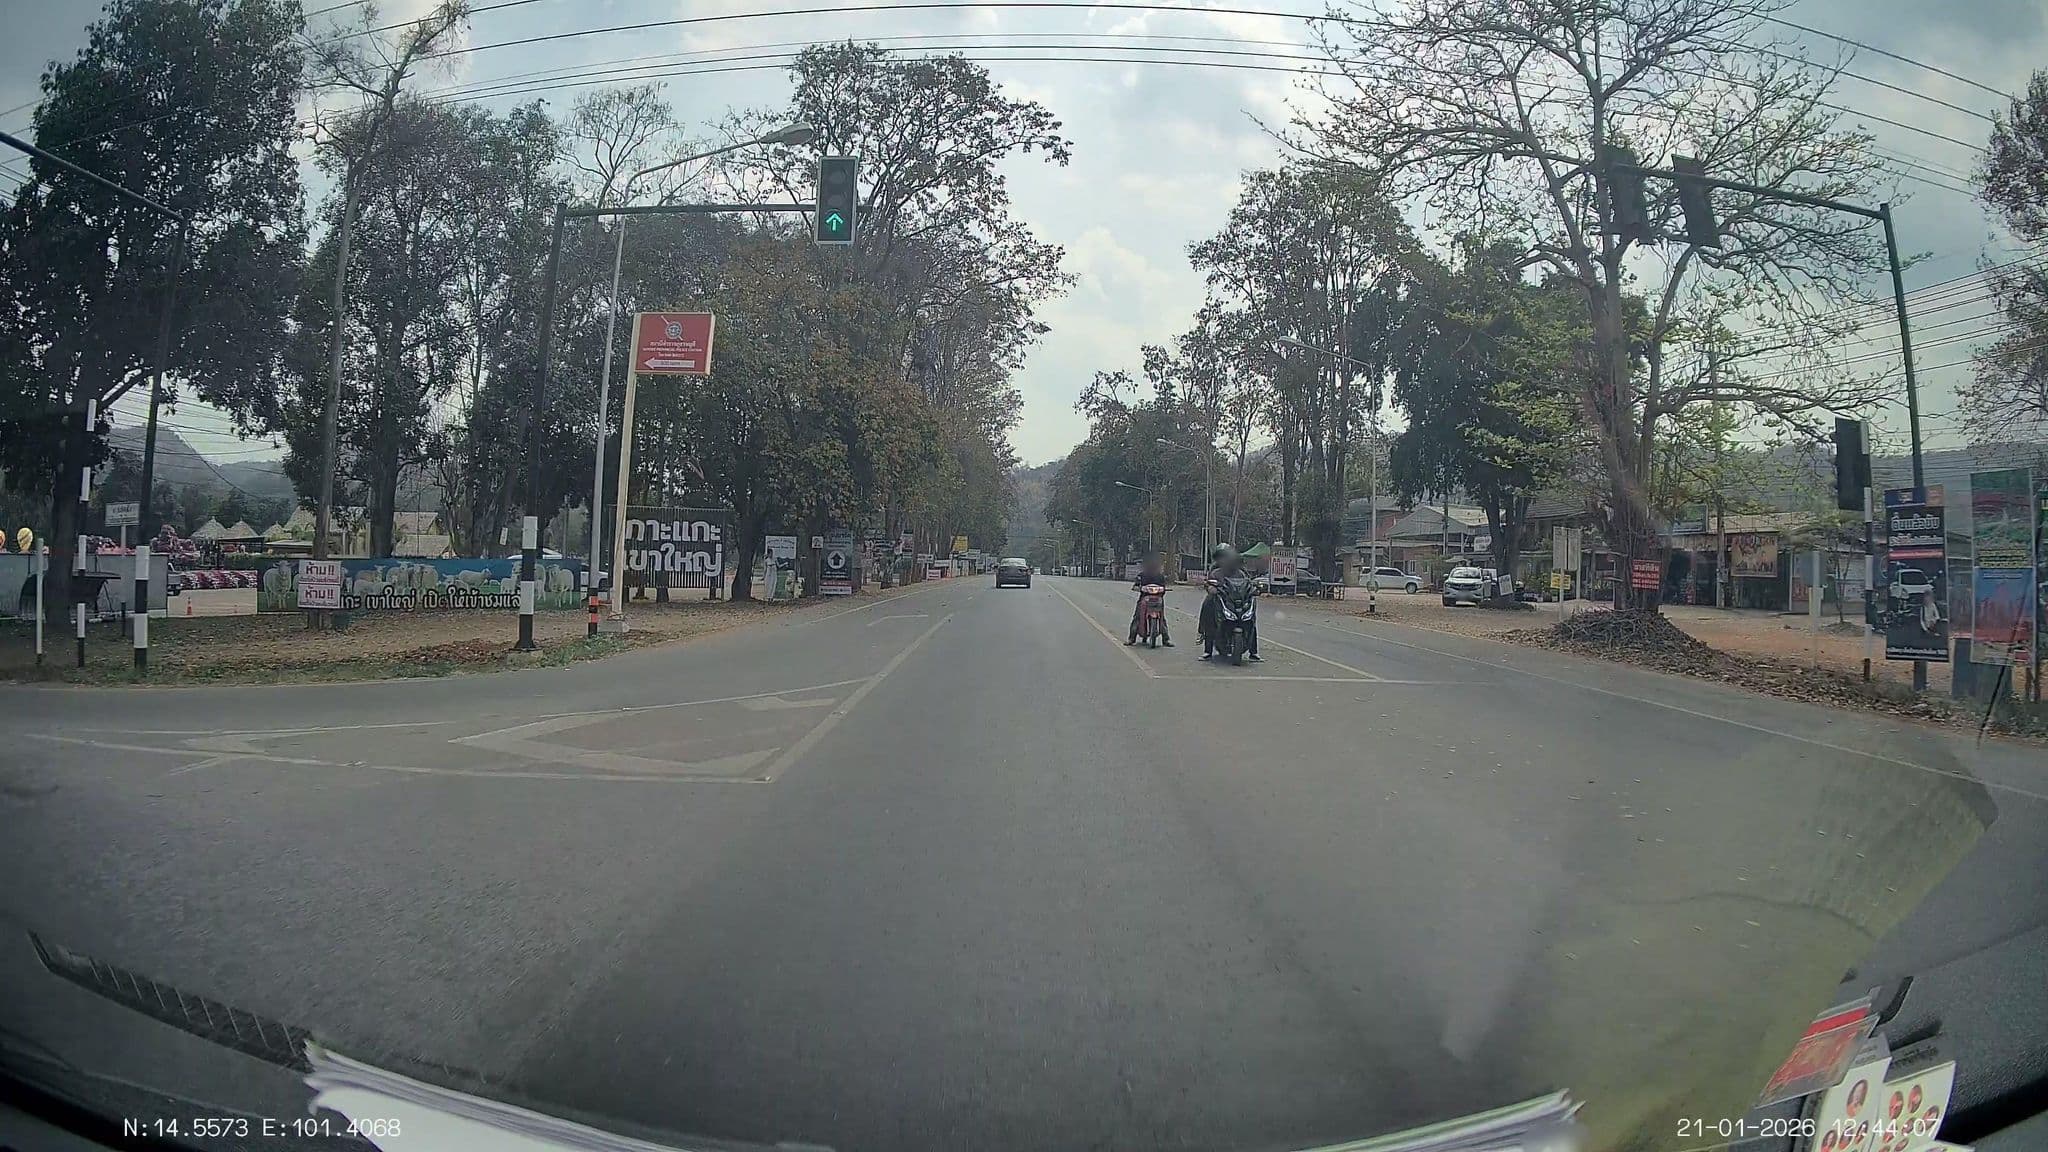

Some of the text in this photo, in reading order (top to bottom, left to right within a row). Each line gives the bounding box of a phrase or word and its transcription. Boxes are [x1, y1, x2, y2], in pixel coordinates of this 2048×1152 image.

[625, 519, 721, 542] กาะแกะ
[306, 561, 335, 576] ห้าม!!
[623, 543, 722, 577] เขาใหญ่
[305, 585, 334, 600] ห้าม!!
[366, 587, 416, 611] เขาใหญ่
